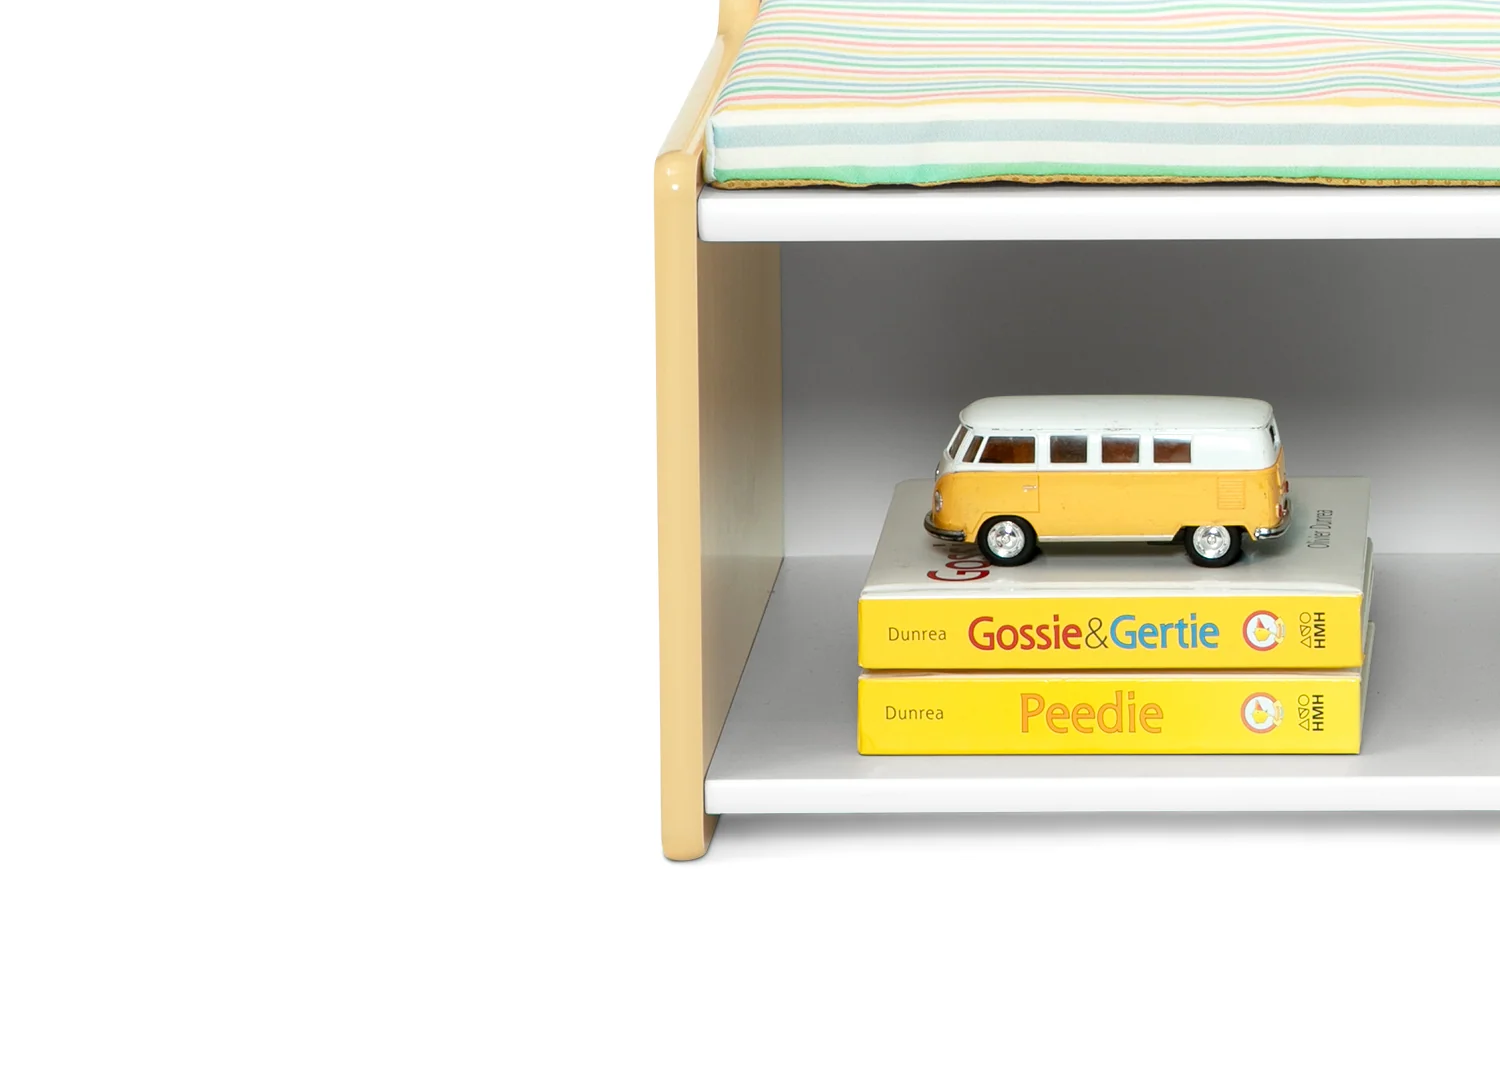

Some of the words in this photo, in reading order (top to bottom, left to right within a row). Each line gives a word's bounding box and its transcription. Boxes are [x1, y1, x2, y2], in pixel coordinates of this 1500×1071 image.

[1309, 509, 1333, 529] Dunrea
[889, 626, 947, 642] Dunrea
[1314, 612, 1326, 648] HMH
[885, 705, 944, 721] Dunrea
[1020, 690, 1164, 734] Peedie
[1312, 695, 1324, 731] HMH
